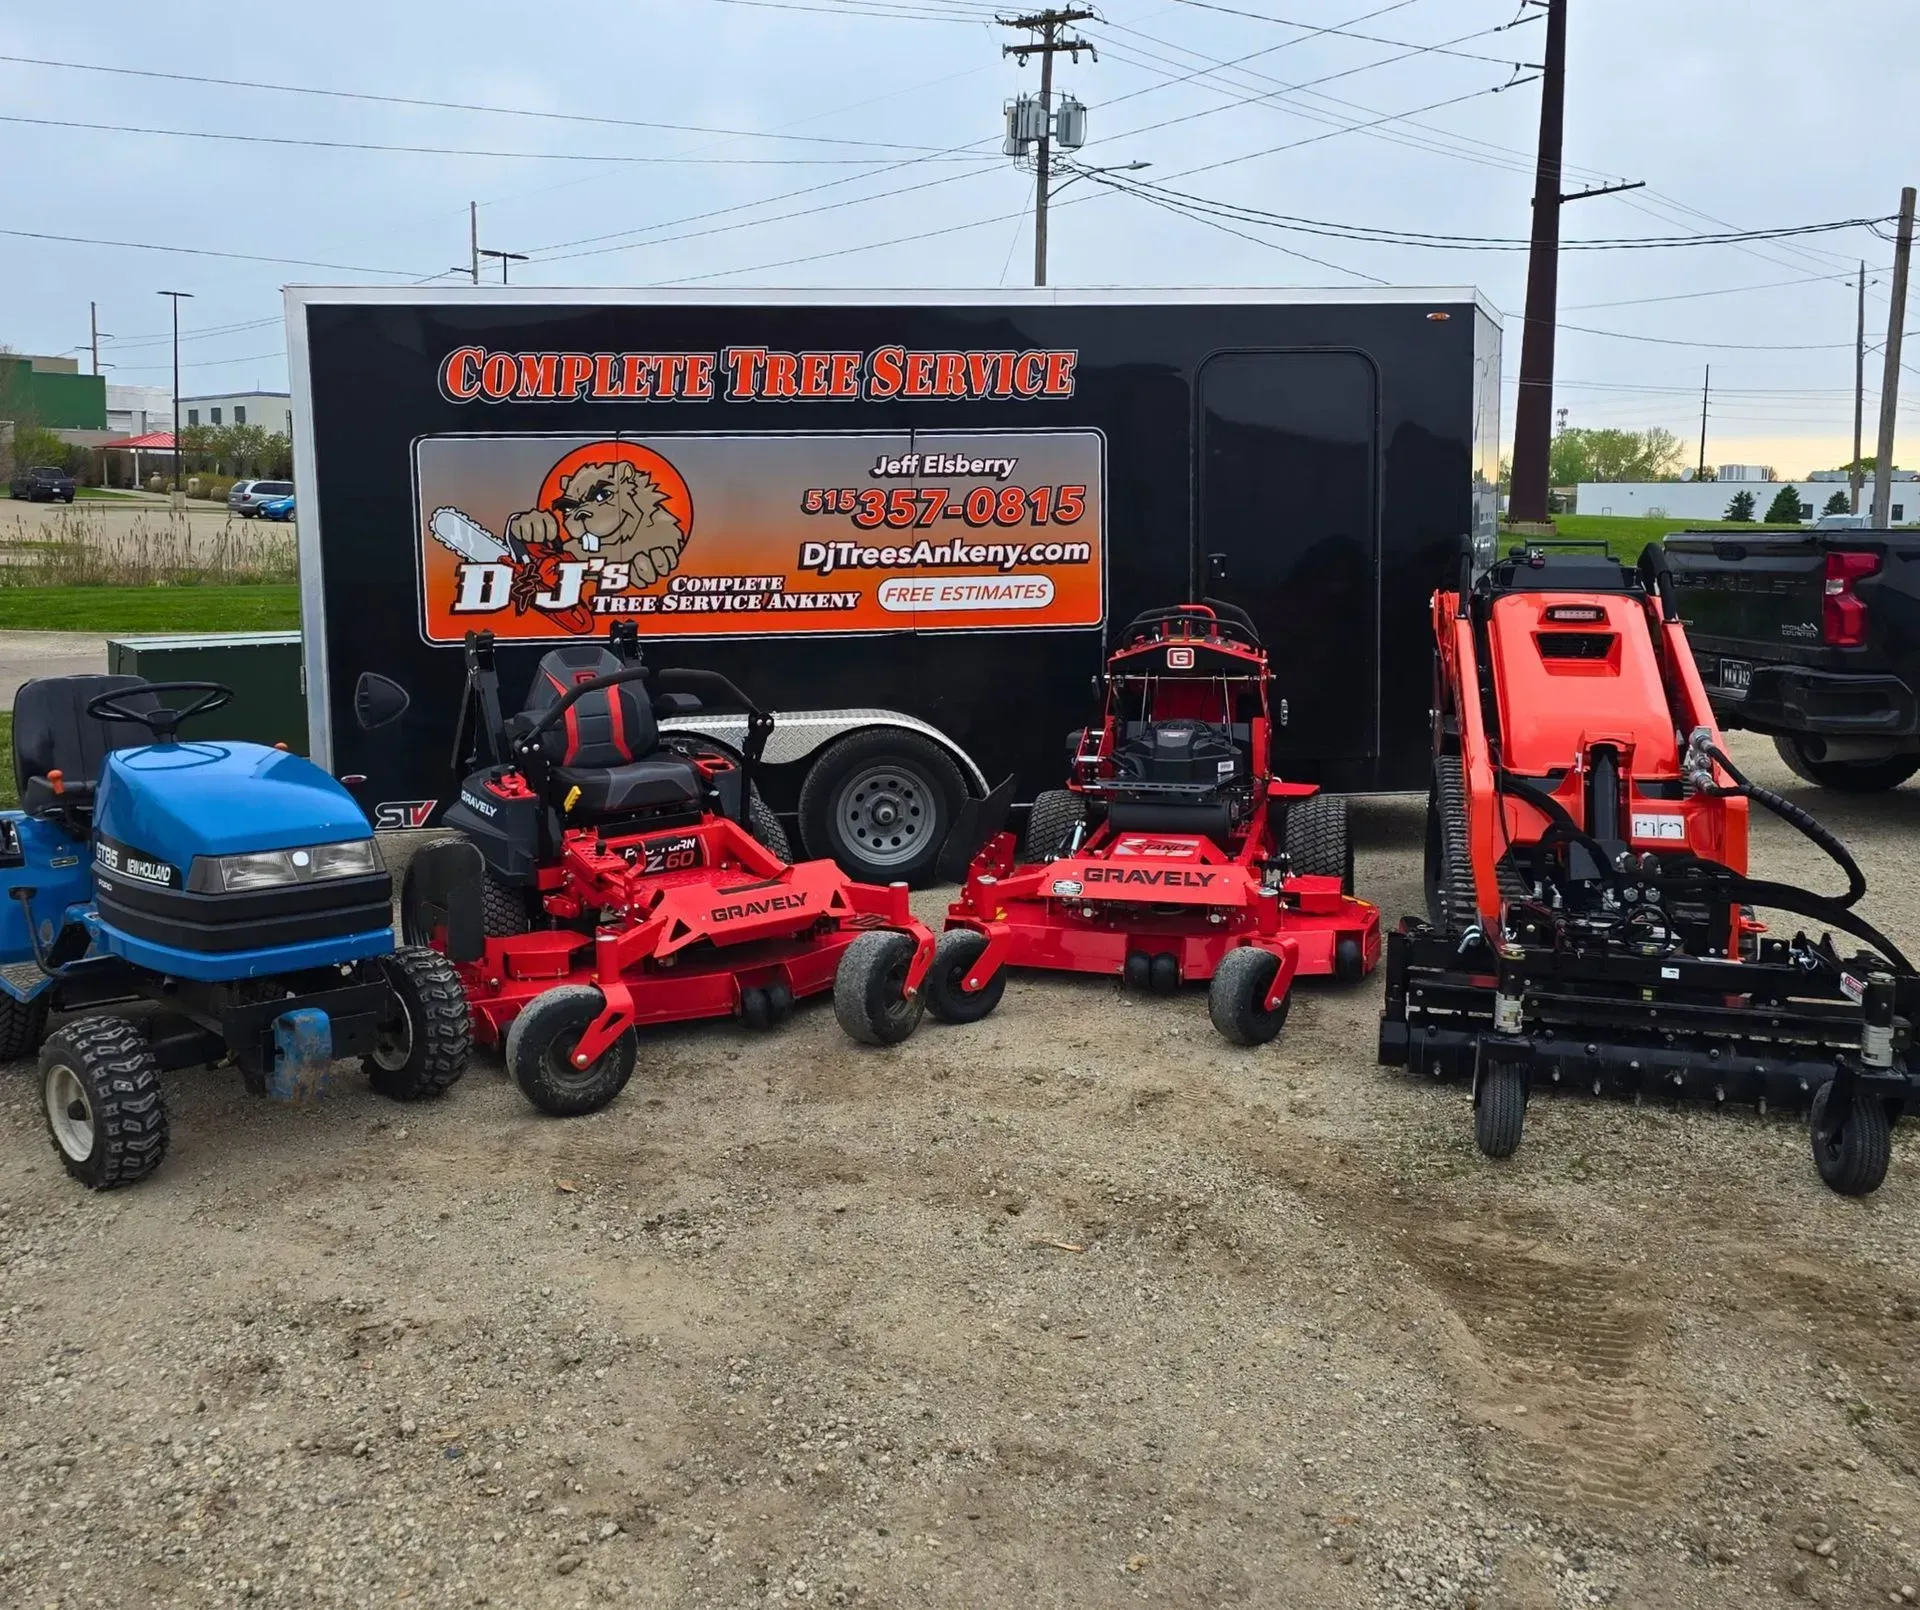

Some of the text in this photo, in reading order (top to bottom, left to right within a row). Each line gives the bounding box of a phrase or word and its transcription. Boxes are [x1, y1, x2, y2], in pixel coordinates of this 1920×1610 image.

[442, 347, 1077, 401] COMPLETE TREE SERVICE
[873, 454, 1016, 478] Jeff Elsberry
[804, 486, 1086, 527] 515 357-0815
[801, 538, 1090, 573] DjTreesAnkeny.com
[671, 576, 784, 593] COMPLETE
[884, 584, 1049, 603] FREE ESTIMATES
[592, 592, 861, 613] TREE SERVICE ANKENY
[461, 790, 498, 817] GRAVELY
[96, 841, 119, 868] GT85
[1084, 867, 1217, 888] GRAVELY
[711, 892, 808, 923] GRAVELY
